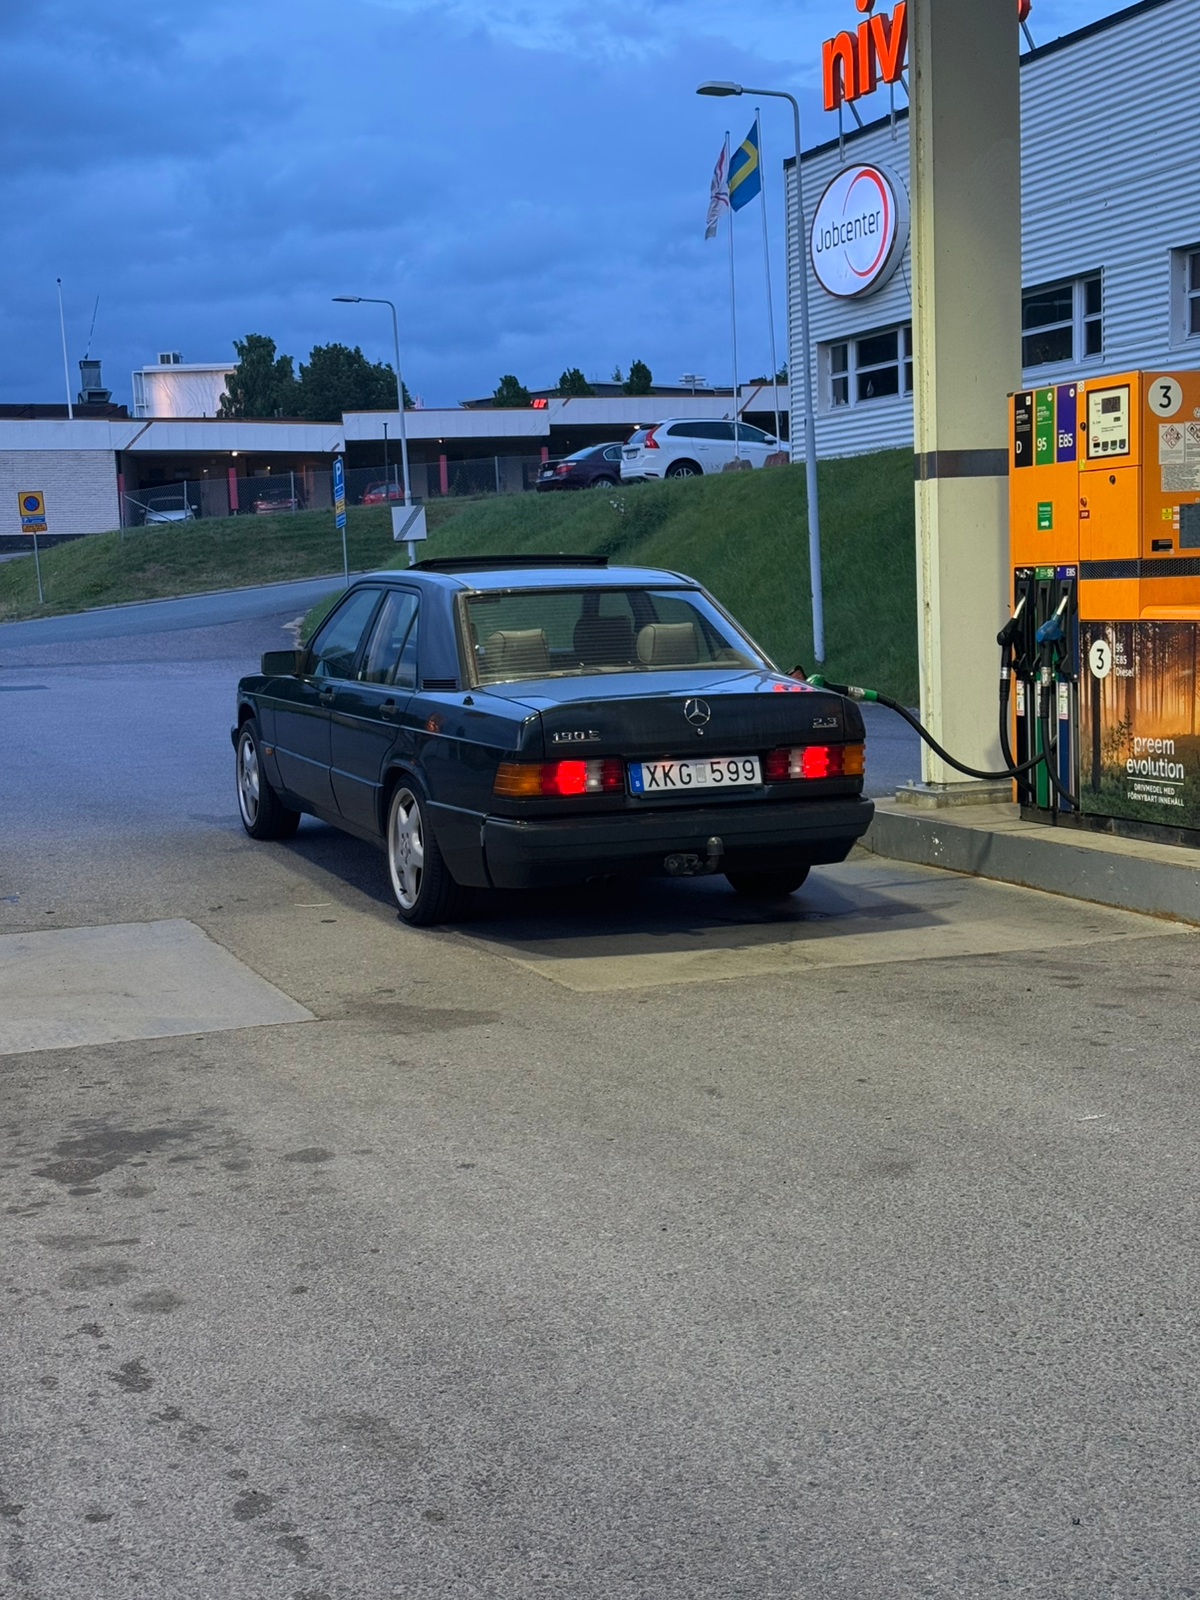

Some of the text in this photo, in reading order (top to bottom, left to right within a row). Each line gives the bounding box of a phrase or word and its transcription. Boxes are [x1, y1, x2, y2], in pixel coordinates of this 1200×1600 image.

[816, 210, 881, 253] Jobcenter
[1159, 385, 1171, 408] 3
[1016, 440, 1022, 454] D
[1037, 437, 1047, 451] 95
[1058, 433, 1073, 448] E85
[335, 462, 342, 484] P
[1066, 568, 1075, 576] E85
[1116, 643, 1124, 652] 95
[1096, 648, 1105, 670] 3
[1116, 655, 1127, 665] E85
[1116, 667, 1134, 677] Diesel
[813, 717, 837, 727] 2.3
[553, 732, 585, 741] 190
[1134, 736, 1174, 755] preem
[646, 760, 755, 788] XKG 599
[1126, 756, 1184, 779] evolution
[1134, 783, 1175, 795] DRIVMEDEL MED
[1127, 791, 1185, 807] FÖRNYBART INNEHÅLL
